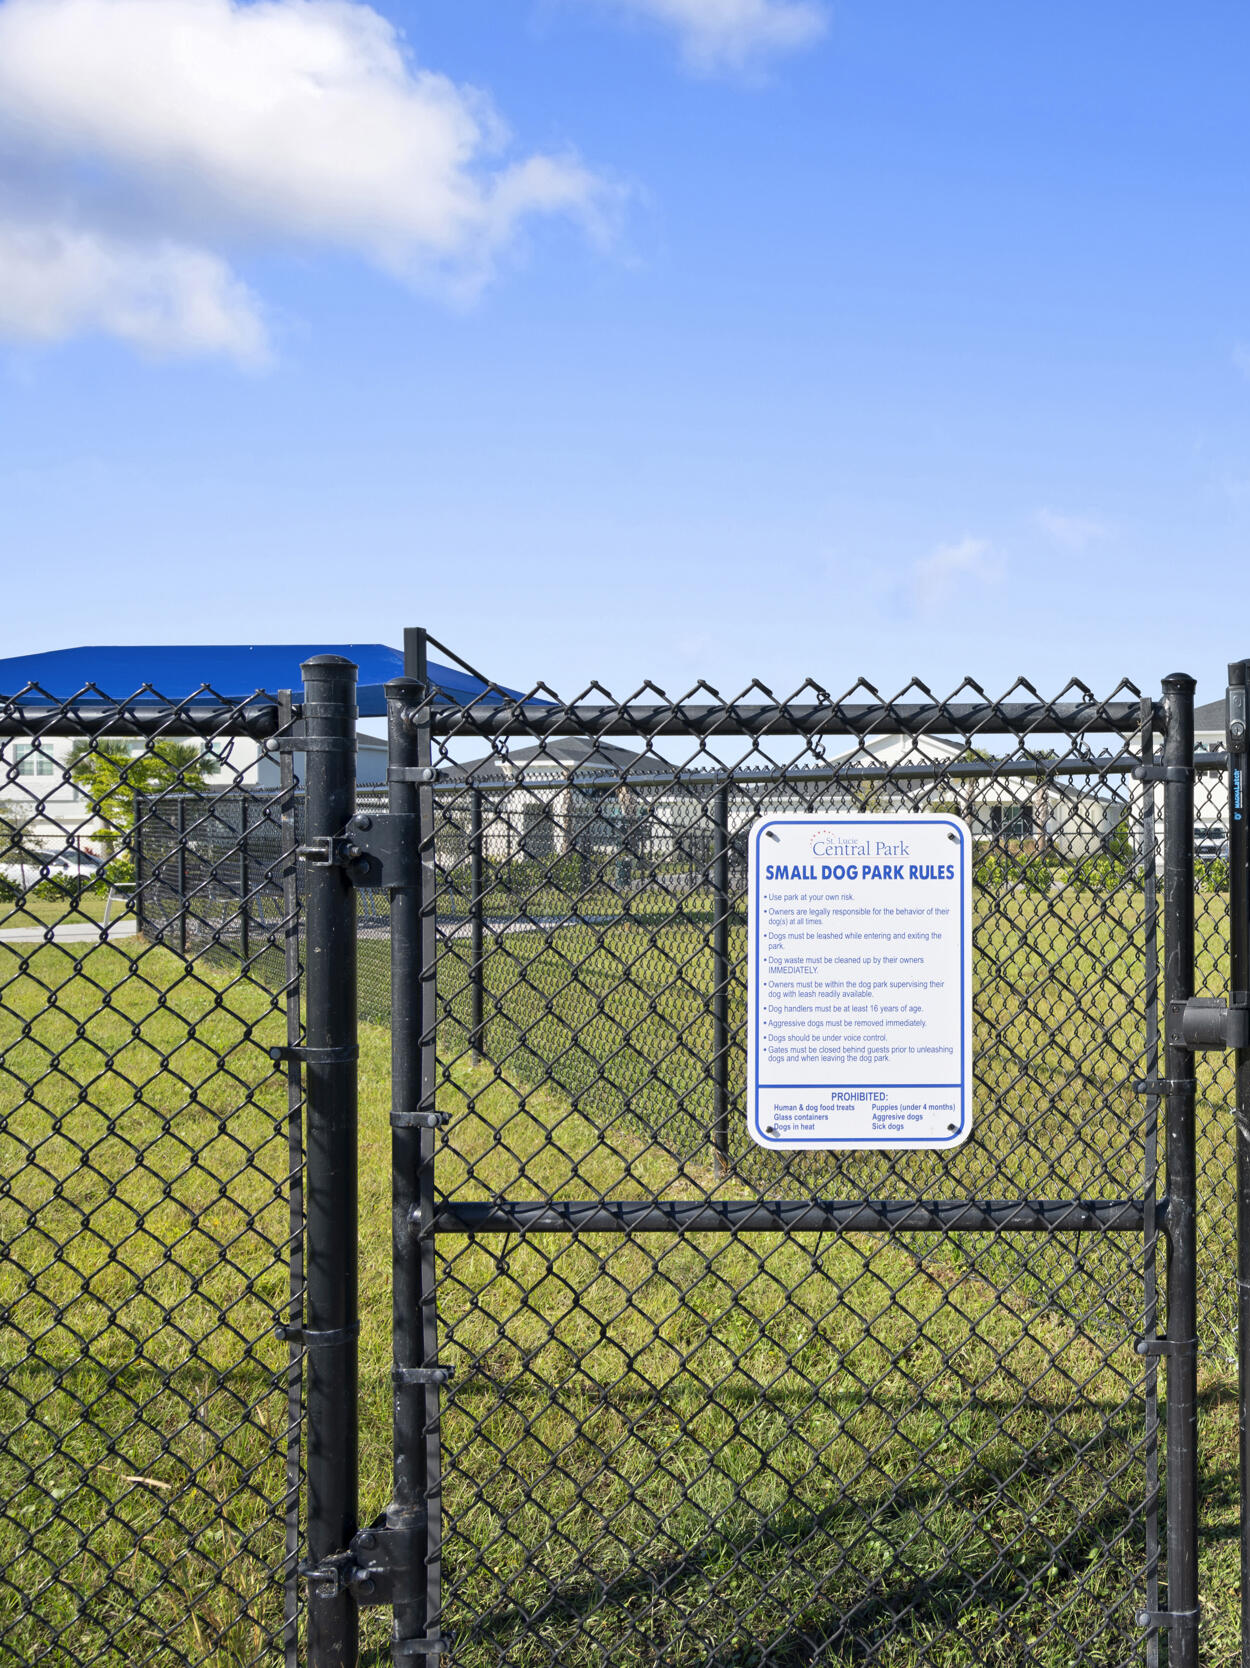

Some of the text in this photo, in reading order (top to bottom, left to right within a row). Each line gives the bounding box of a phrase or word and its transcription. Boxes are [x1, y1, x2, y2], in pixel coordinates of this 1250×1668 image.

[812, 840, 910, 856] Central Park
[766, 864, 954, 880] SMALL DOG PARK RULES
[768, 893, 782, 901] Use
[784, 893, 799, 902] park
[800, 893, 807, 901] at
[808, 894, 824, 902] your
[768, 907, 795, 916] Owners
[808, 908, 831, 917] legally
[832, 907, 871, 917] responsible
[872, 907, 882, 915] for
[883, 907, 895, 915] the
[926, 907, 934, 915] of
[934, 907, 950, 915] their
[768, 917, 788, 927] dog(s)
[768, 956, 783, 966] Dog
[823, 956, 833, 964] be
[834, 956, 861, 964] cleaned
[862, 957, 872, 965] up
[873, 956, 882, 965] by
[882, 956, 898, 964] their
[768, 1004, 782, 1013] Dog
[784, 1005, 813, 1013] handlers
[843, 1005, 850, 1013] at
[851, 1005, 868, 1013] least
[870, 1004, 878, 1012] 16
[900, 1004, 908, 1012] of
[768, 1033, 786, 1042] Dogs
[787, 1033, 811, 1042] should
[811, 1034, 821, 1042] be
[822, 1034, 842, 1042] under
[843, 1034, 862, 1042] voice
[831, 1092, 888, 1101] PROHIBITED:
[798, 1103, 804, 1111] &
[805, 1104, 818, 1112] dog
[871, 1103, 898, 1112] Puppies
[900, 1104, 921, 1112] (under
[928, 1104, 955, 1112] months)
[774, 1113, 793, 1121] Glass
[872, 1113, 923, 1122] Aggresive dogs
[774, 1123, 791, 1131] Dogs
[872, 1122, 904, 1131] Sick dogs
